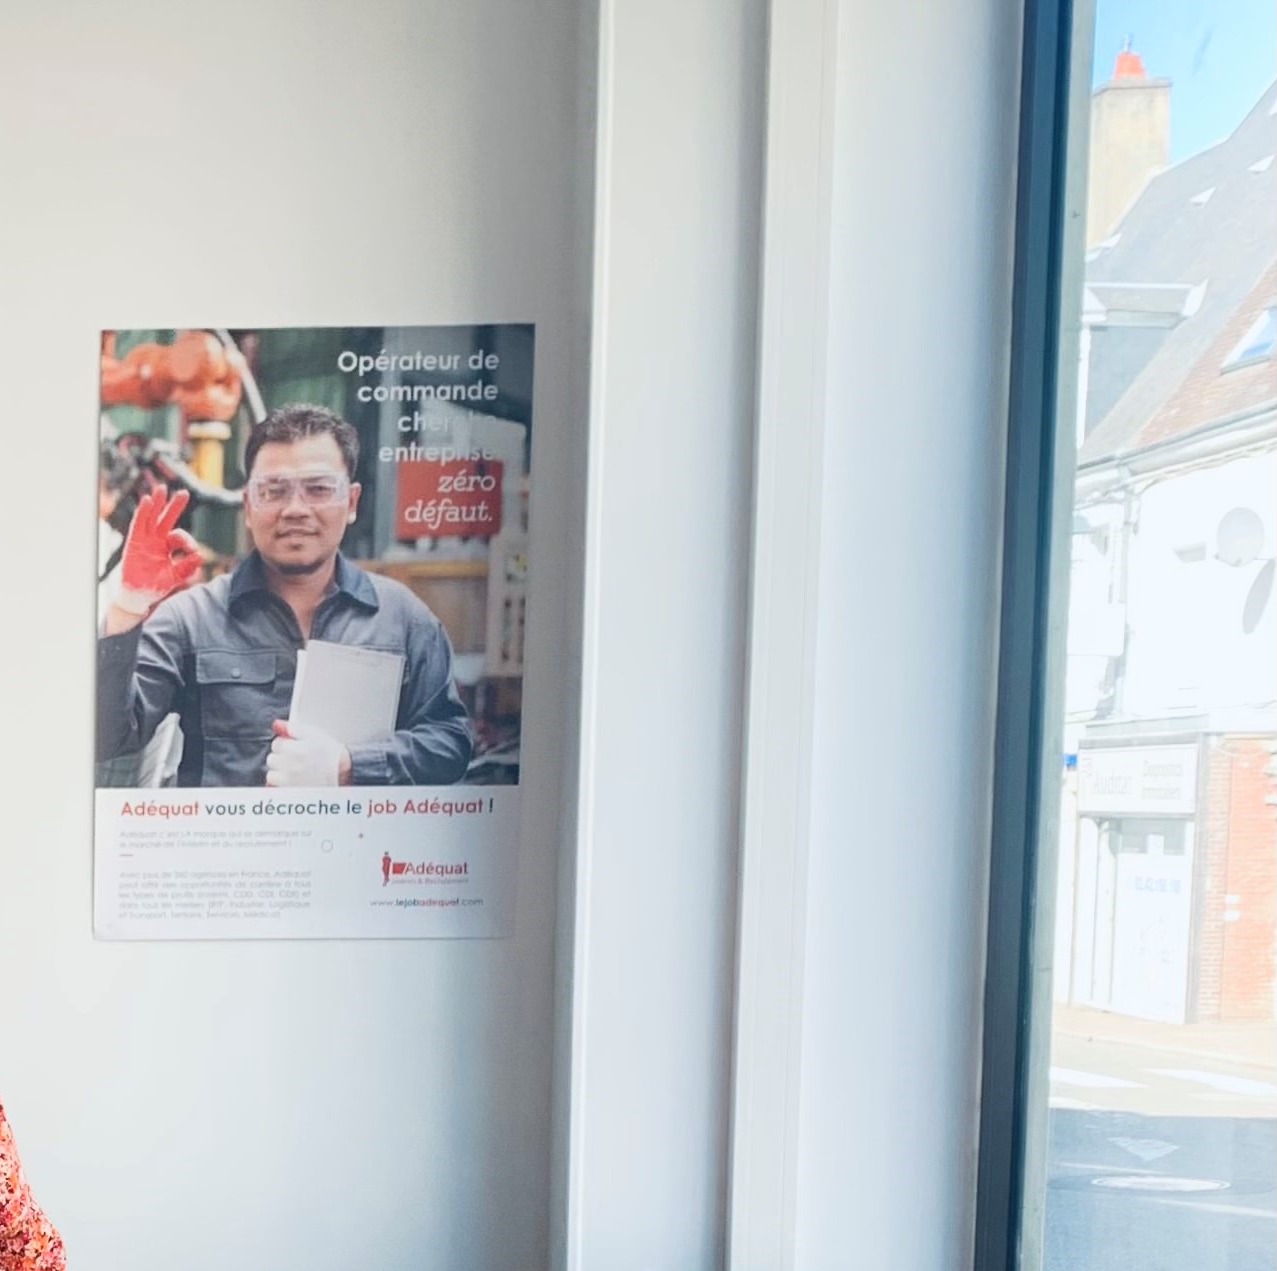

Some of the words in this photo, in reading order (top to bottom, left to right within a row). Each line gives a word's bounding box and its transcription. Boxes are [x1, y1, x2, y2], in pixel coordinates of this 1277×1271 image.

[337, 349, 461, 377] Opérateur
[468, 350, 499, 370] de
[357, 380, 498, 403] commande
[437, 469, 496, 492] zéro
[404, 499, 493, 529] défaut.
[121, 800, 199, 820] Adéquat
[205, 803, 246, 816] vous
[252, 800, 341, 816] décroche
[347, 800, 362, 815] le
[366, 799, 397, 818] job
[403, 798, 483, 818] Adéquat
[489, 797, 494, 813] !
[404, 861, 468, 876] Adéquat
[369, 898, 484, 909] www.lejobadequat.com
